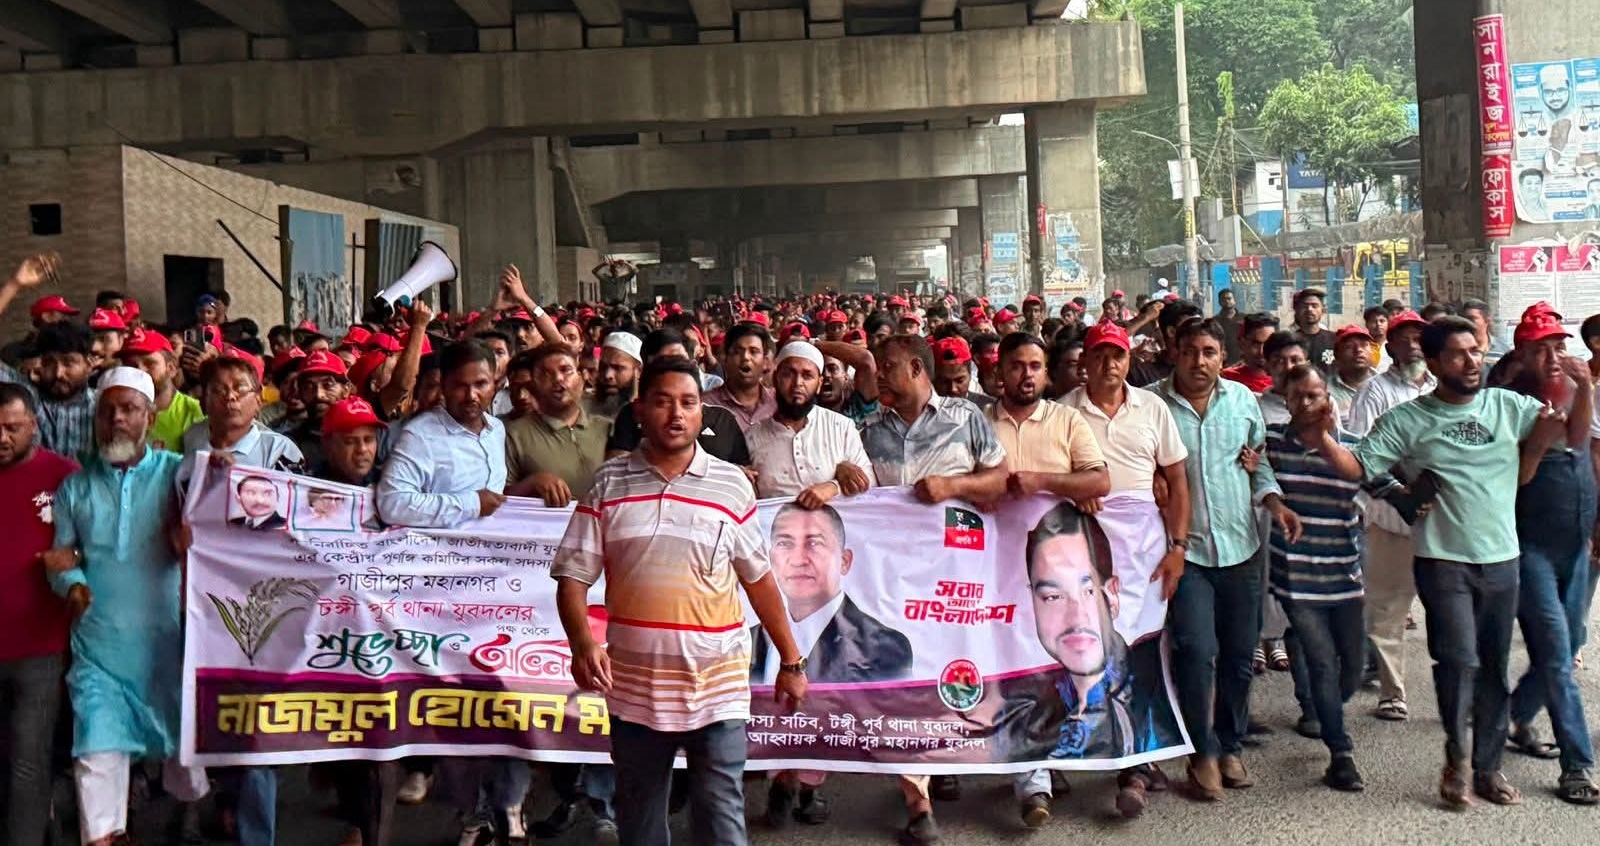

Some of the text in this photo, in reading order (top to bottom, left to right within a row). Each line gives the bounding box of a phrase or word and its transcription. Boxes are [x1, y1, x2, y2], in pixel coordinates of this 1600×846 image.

[1476, 20, 1505, 123] সানরাইজ
[1481, 165, 1509, 223] ফোকাস
[421, 551, 472, 565] কমিটির
[446, 536, 538, 553] জাতীয়তাবাদী
[336, 567, 522, 596] গাজীপুর মহানগর ও
[935, 580, 985, 599] সবার
[317, 595, 537, 624] টঙ্গী পূর্ব থানা যুবদলের
[904, 598, 1017, 626] বাংলাদেশ
[306, 627, 471, 679] শুভেচ্ছা
[469, 633, 573, 677] অভিন
[216, 689, 398, 744] নাজমুল
[409, 688, 568, 733] হোসেন
[828, 711, 857, 731] টঙ্গী
[862, 713, 886, 736] পূর্ব
[887, 718, 918, 733] থানা
[823, 731, 879, 751] গাজীপুর
[883, 735, 940, 749] মহানগর
[944, 737, 986, 753] যুবদল
